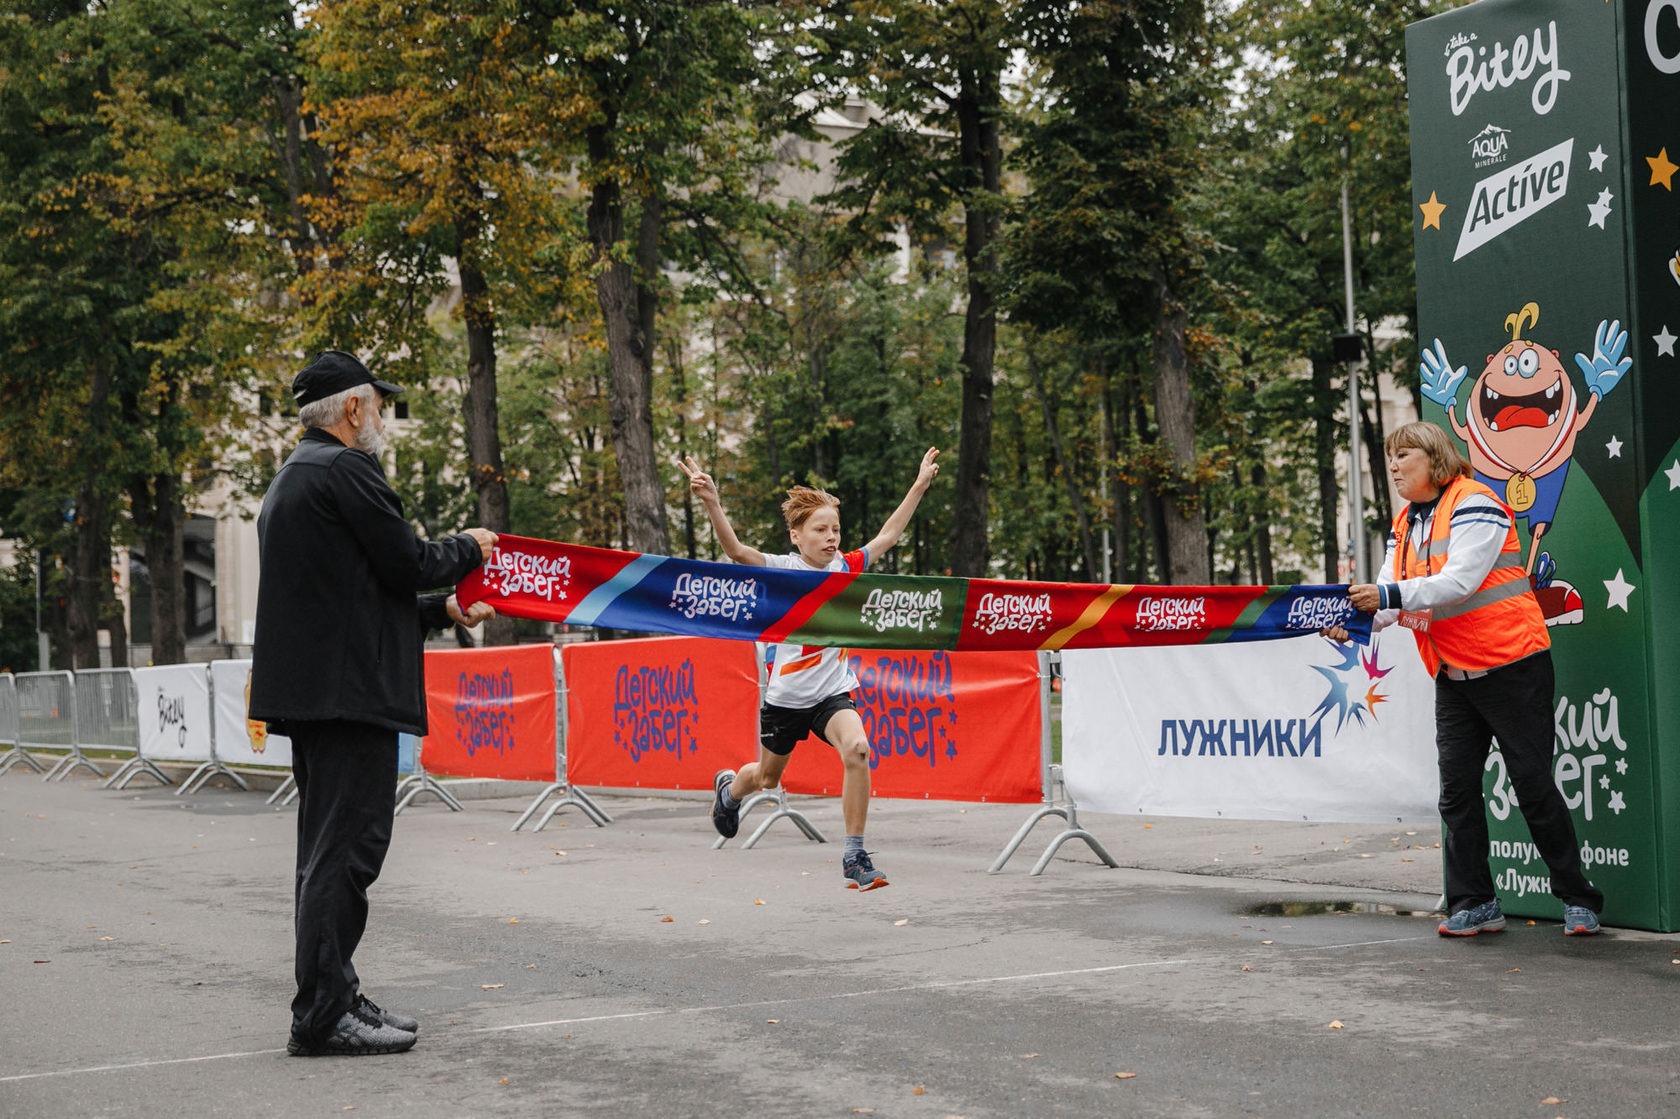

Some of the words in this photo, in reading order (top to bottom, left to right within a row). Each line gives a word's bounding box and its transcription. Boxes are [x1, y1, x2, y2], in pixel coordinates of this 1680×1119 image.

[1445, 20, 1571, 116] Bitey
[1472, 133, 1508, 158] AQUA
[1474, 153, 1507, 169] MINERALE
[1516, 483, 1529, 505] 1
[484, 547, 571, 578] Детский
[672, 573, 757, 600] Детский
[861, 588, 942, 614] Детский
[975, 593, 1052, 620] Детский
[1136, 597, 1205, 622] Детский
[614, 658, 698, 724] Детский
[1158, 719, 1322, 757] ЛУЖНИКИ
